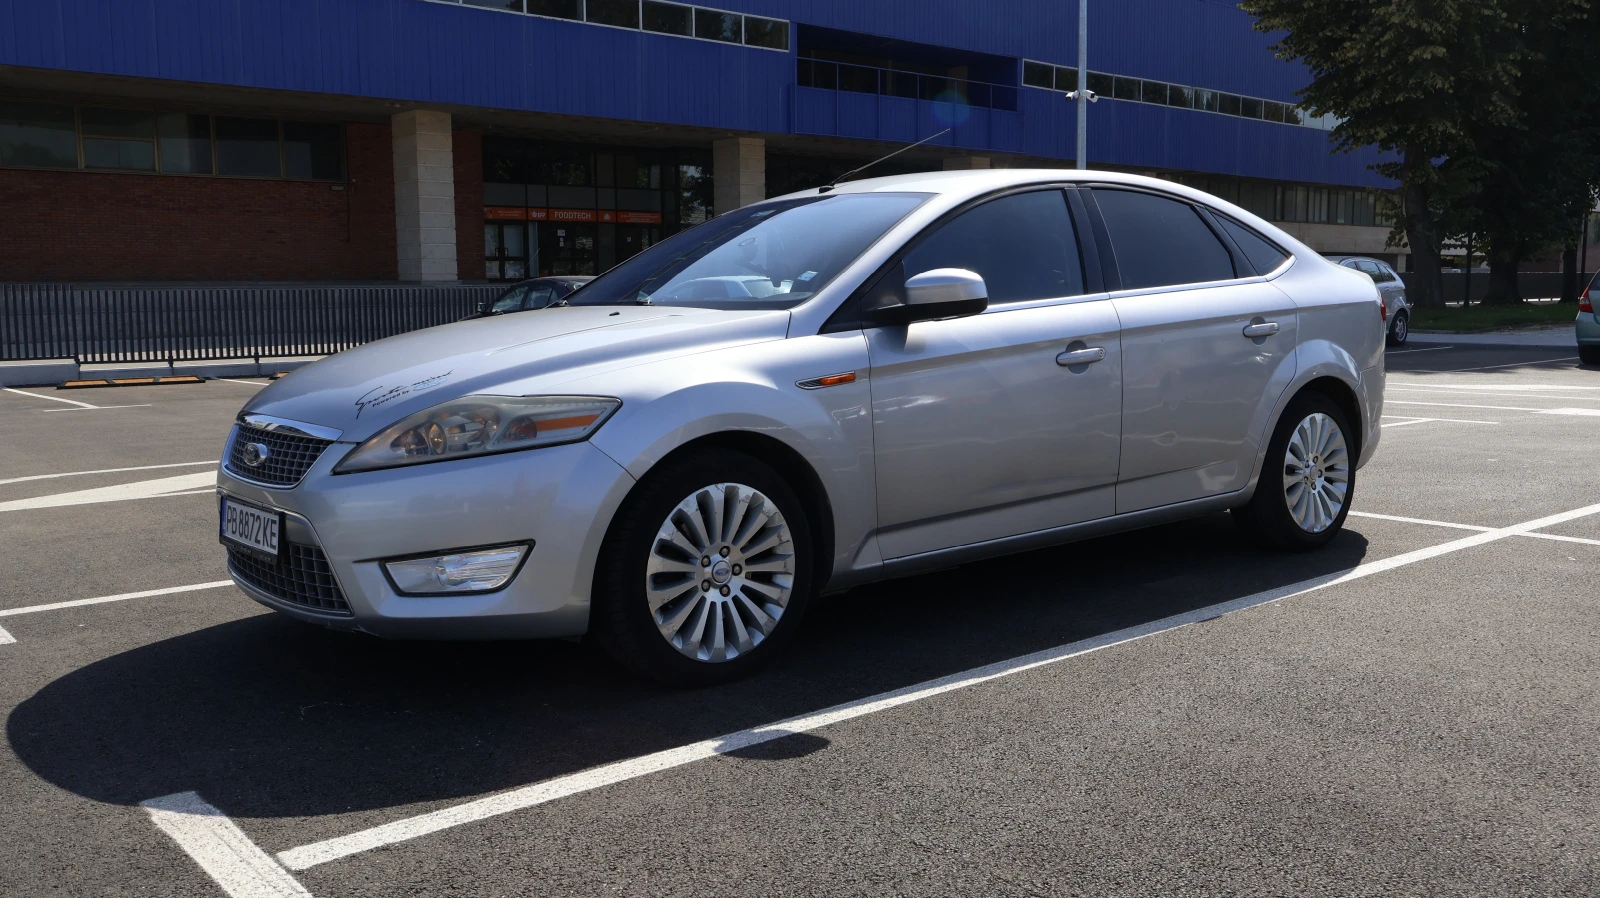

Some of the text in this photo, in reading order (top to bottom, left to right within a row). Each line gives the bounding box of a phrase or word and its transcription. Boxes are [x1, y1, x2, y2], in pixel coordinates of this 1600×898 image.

[554, 211, 591, 220] FOODTECH
[226, 504, 277, 551] PB 8872 KE
